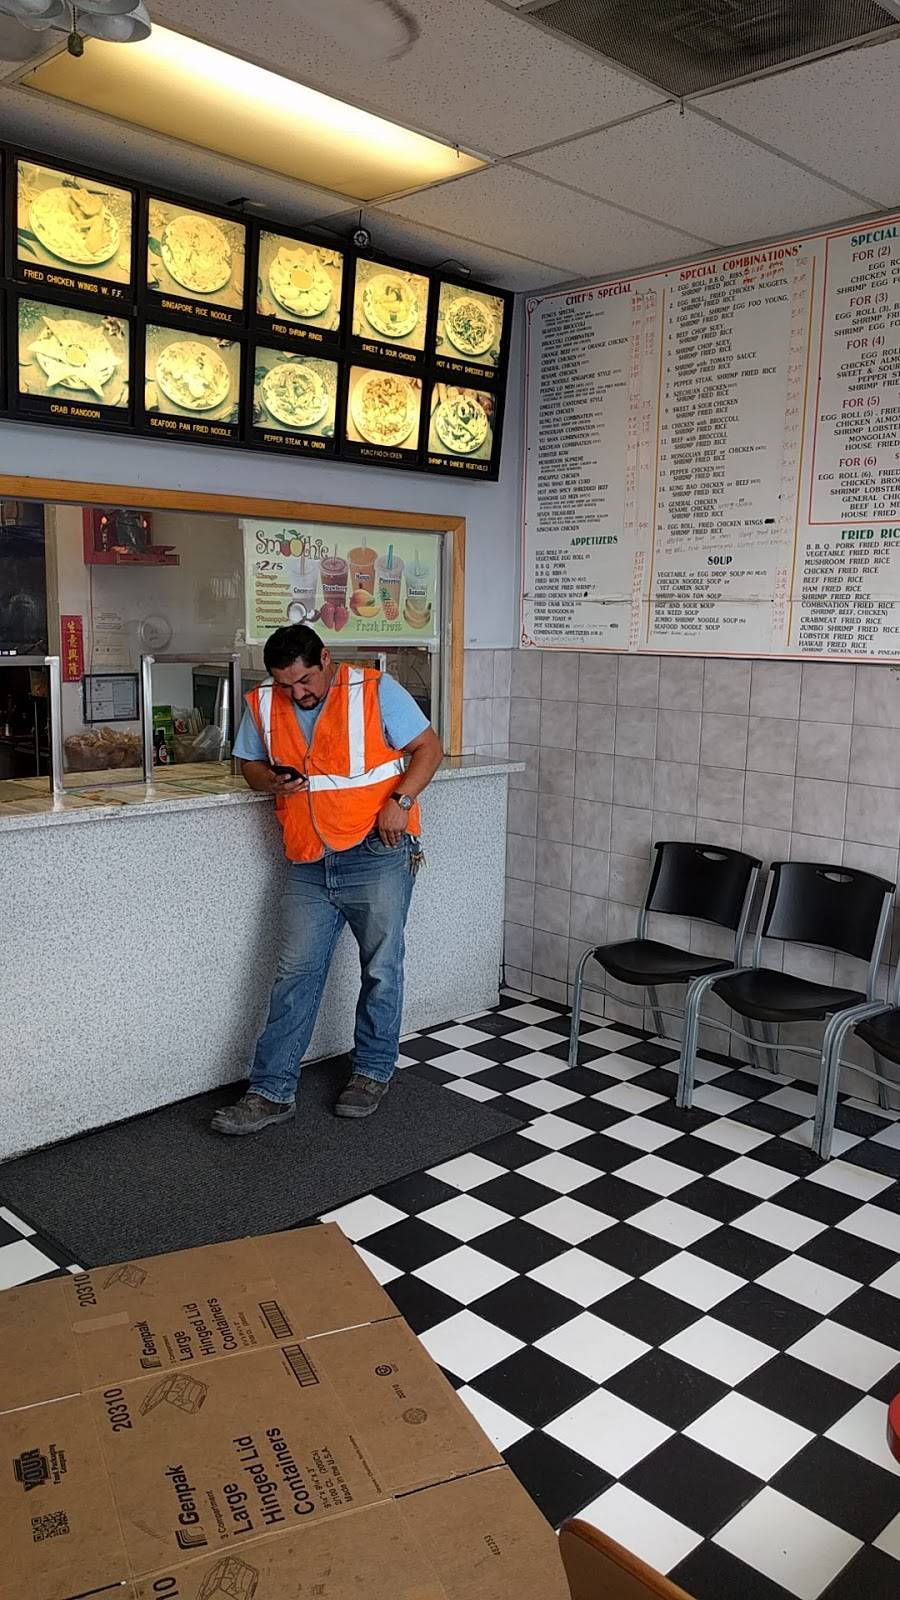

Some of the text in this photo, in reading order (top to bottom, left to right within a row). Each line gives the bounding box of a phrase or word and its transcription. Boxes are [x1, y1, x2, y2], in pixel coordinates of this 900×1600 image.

[851, 227, 898, 247] SPECIAL
[852, 246, 891, 262] FOR (2)
[680, 247, 798, 281] SPECIAL COMBINATIONS
[24, 269, 44, 281] FRIED
[47, 275, 74, 288] CHICKEN
[78, 281, 98, 292] WINGS
[101, 287, 109, 296] W.
[851, 271, 886, 283] CHICKEN
[566, 292, 593, 305] CHEF'S
[598, 284, 632, 298] SPECIAL
[729, 286, 754, 295] CHICKEN
[836, 284, 866, 295] SHRIMP
[850, 292, 888, 307] FOR (3)
[162, 300, 232, 322] SINGAPORE RICE NOODLE
[856, 308, 876, 317] ROLL
[272, 324, 286, 334] FRIED
[846, 336, 885, 350] FOR (4)
[363, 344, 377, 353] SWEET
[385, 349, 397, 357] SOUR
[398, 351, 416, 362] CHICKEN
[841, 361, 875, 370] CHICKEN
[674, 379, 692, 387] PEPPER
[717, 372, 738, 380] SHRIMP
[842, 396, 880, 409] FOR (5)
[50, 405, 100, 418] CRAB RANGOON
[150, 418, 232, 437] SEAFOOD PAN FRIED NOODLE
[285, 437, 301, 445] STEAK
[849, 432, 896, 442] MONGOLIAN
[878, 440, 900, 448] FRIED
[840, 456, 876, 467] FOR (6)
[570, 536, 618, 546] APPETIZERS
[841, 529, 874, 540] FRIED
[256, 529, 329, 560] Smoothie
[708, 556, 732, 565] SOUP
[73, 1274, 97, 1307] 20310
[183, 1303, 216, 1356] Hinged Lid
[208, 1298, 238, 1351] Containers
[134, 1321, 157, 1356] Genpak
[174, 1331, 194, 1362] Large
[104, 1388, 132, 1432] 20310
[21, 1448, 45, 1492] YOUR
[266, 1428, 315, 1515] Containers
[332, 1466, 340, 1478] the
[233, 1435, 285, 1525] Hinged Lid
[166, 1464, 200, 1525] Genpak
[341, 1484, 353, 1502] Made
[223, 1483, 254, 1535] Large
